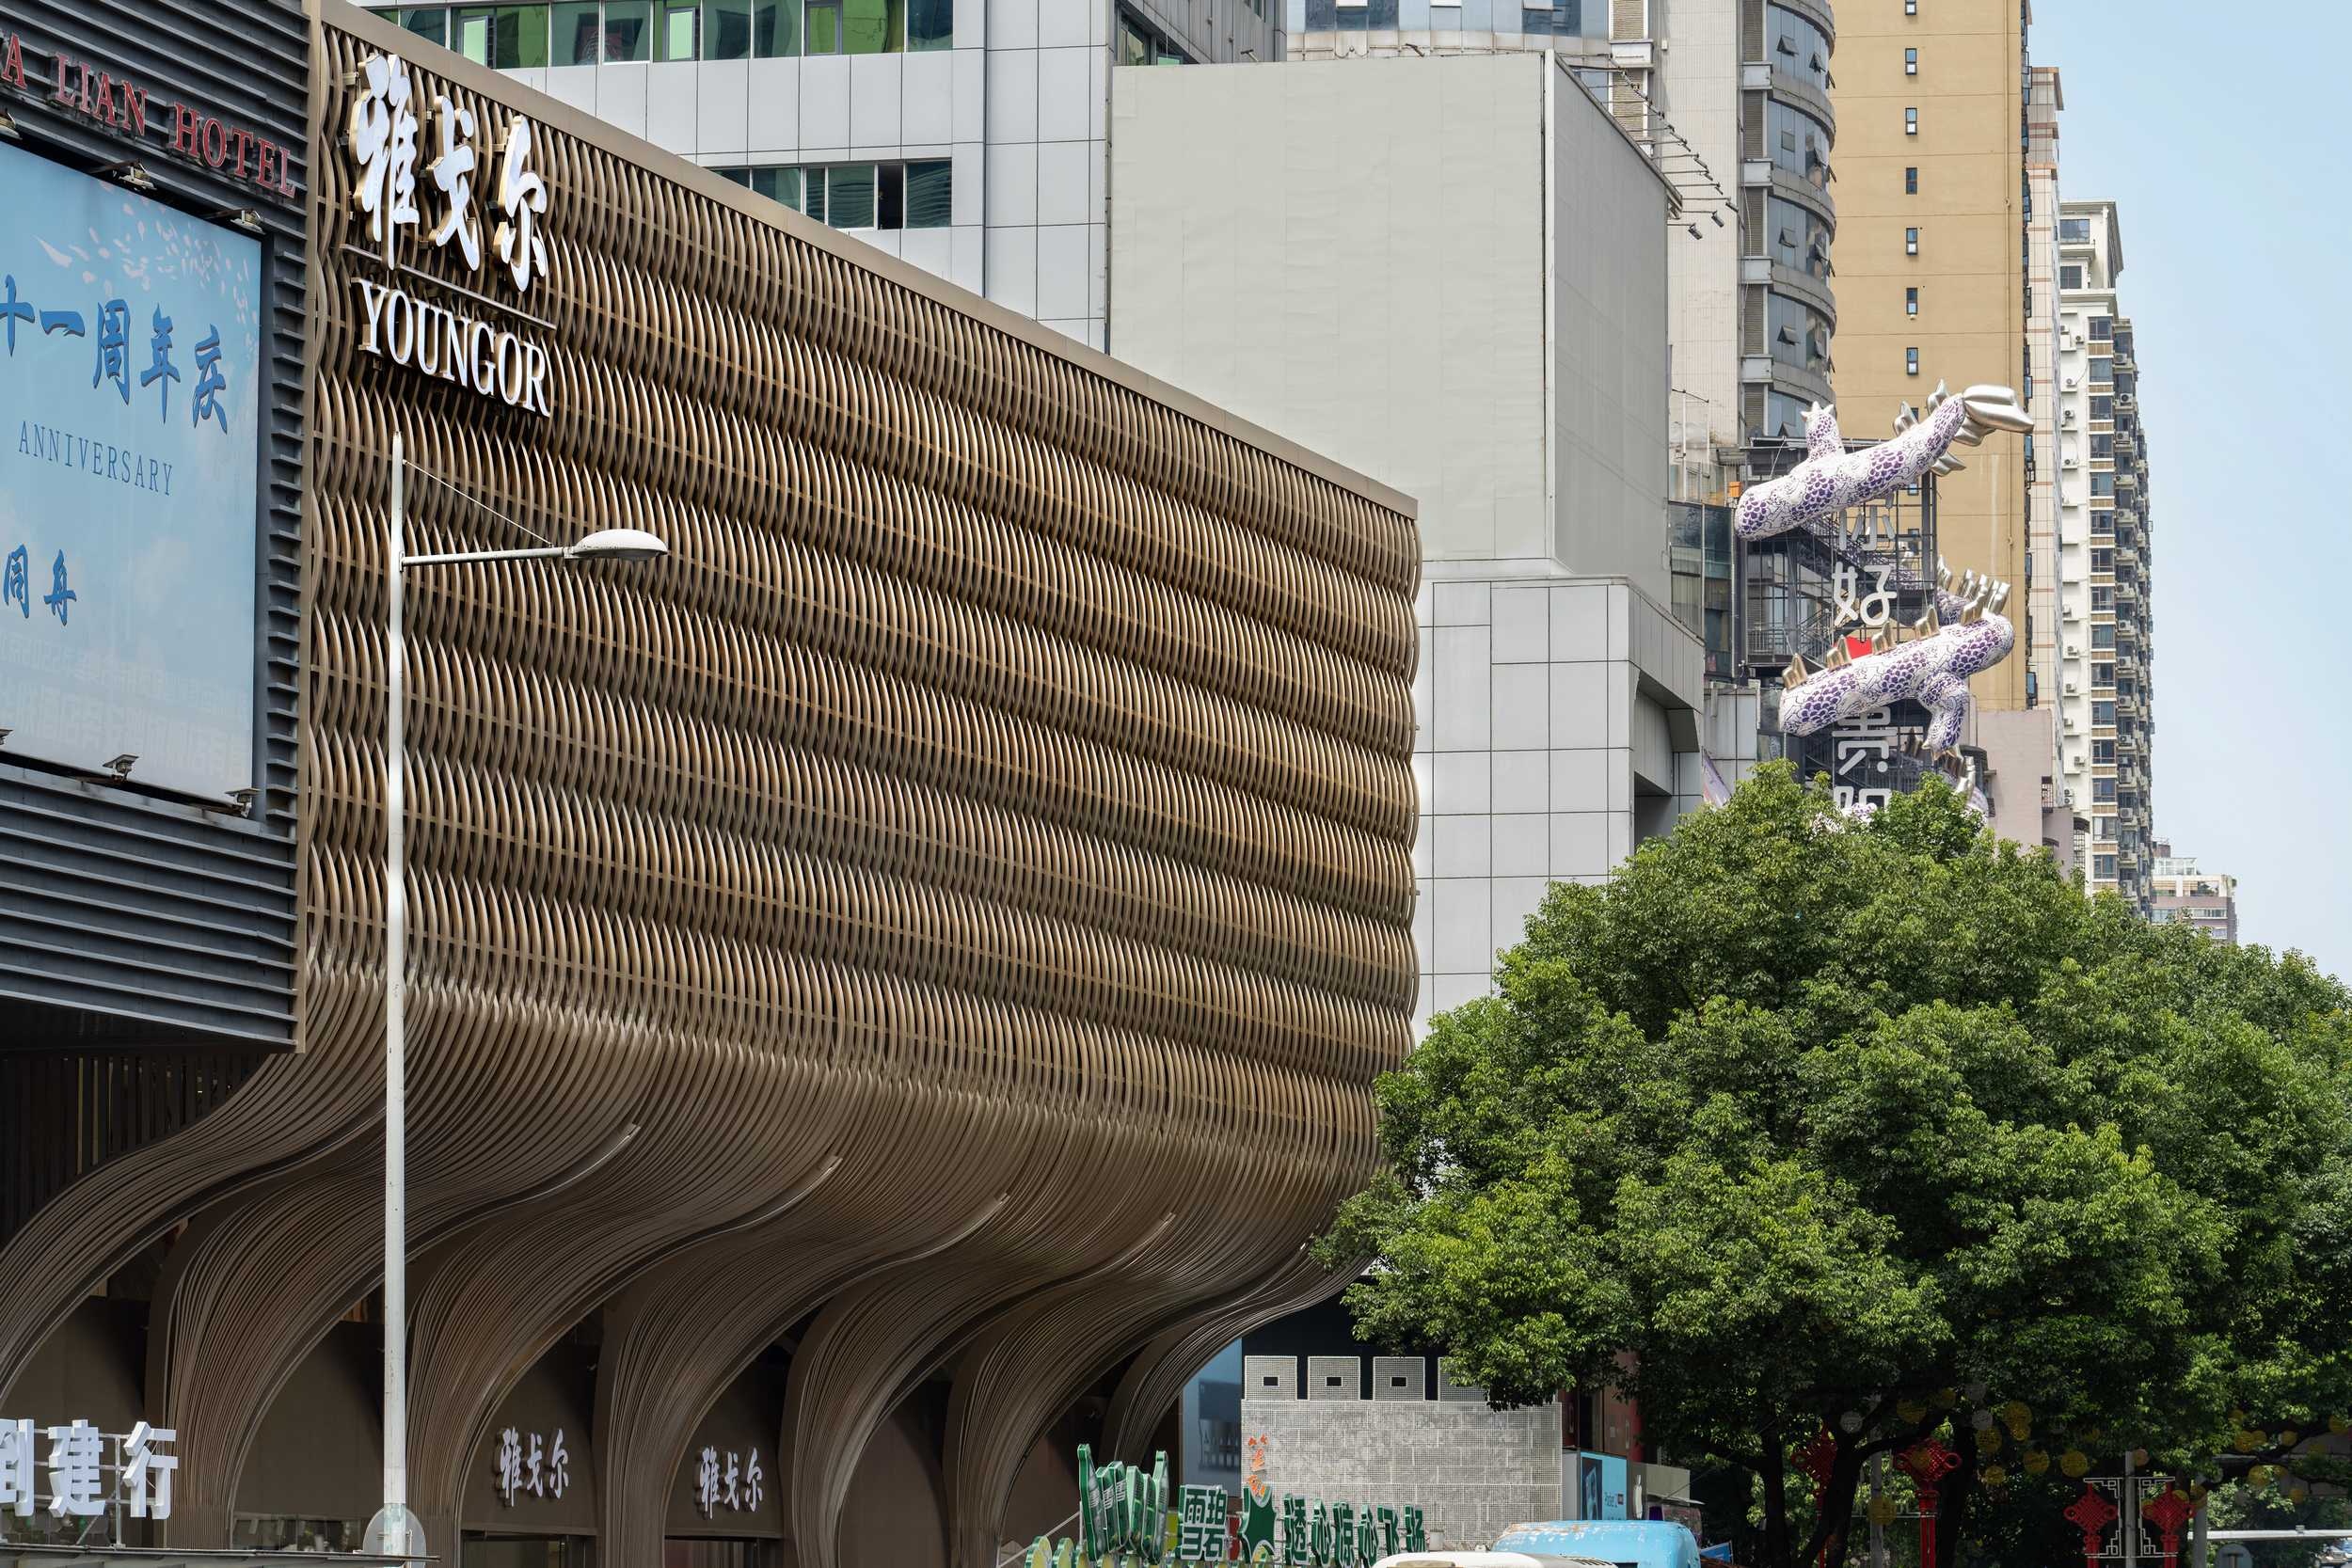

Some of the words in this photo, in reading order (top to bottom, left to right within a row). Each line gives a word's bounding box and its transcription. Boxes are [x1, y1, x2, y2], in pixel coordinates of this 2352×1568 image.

[54, 52, 148, 136] LIAN
[173, 101, 296, 198] HOTEL
[352, 54, 548, 293] 雅戈尔
[0, 274, 228, 435] 十一周年庆
[353, 277, 551, 417] YOUNGOR
[19, 420, 172, 496] ANNIVERSARY
[0, 1418, 179, 1519] 到建行
[499, 1426, 569, 1507] 雅戈尔
[699, 1445, 763, 1519] 雅戈尔
[1180, 1483, 1228, 1561] 雪碧
